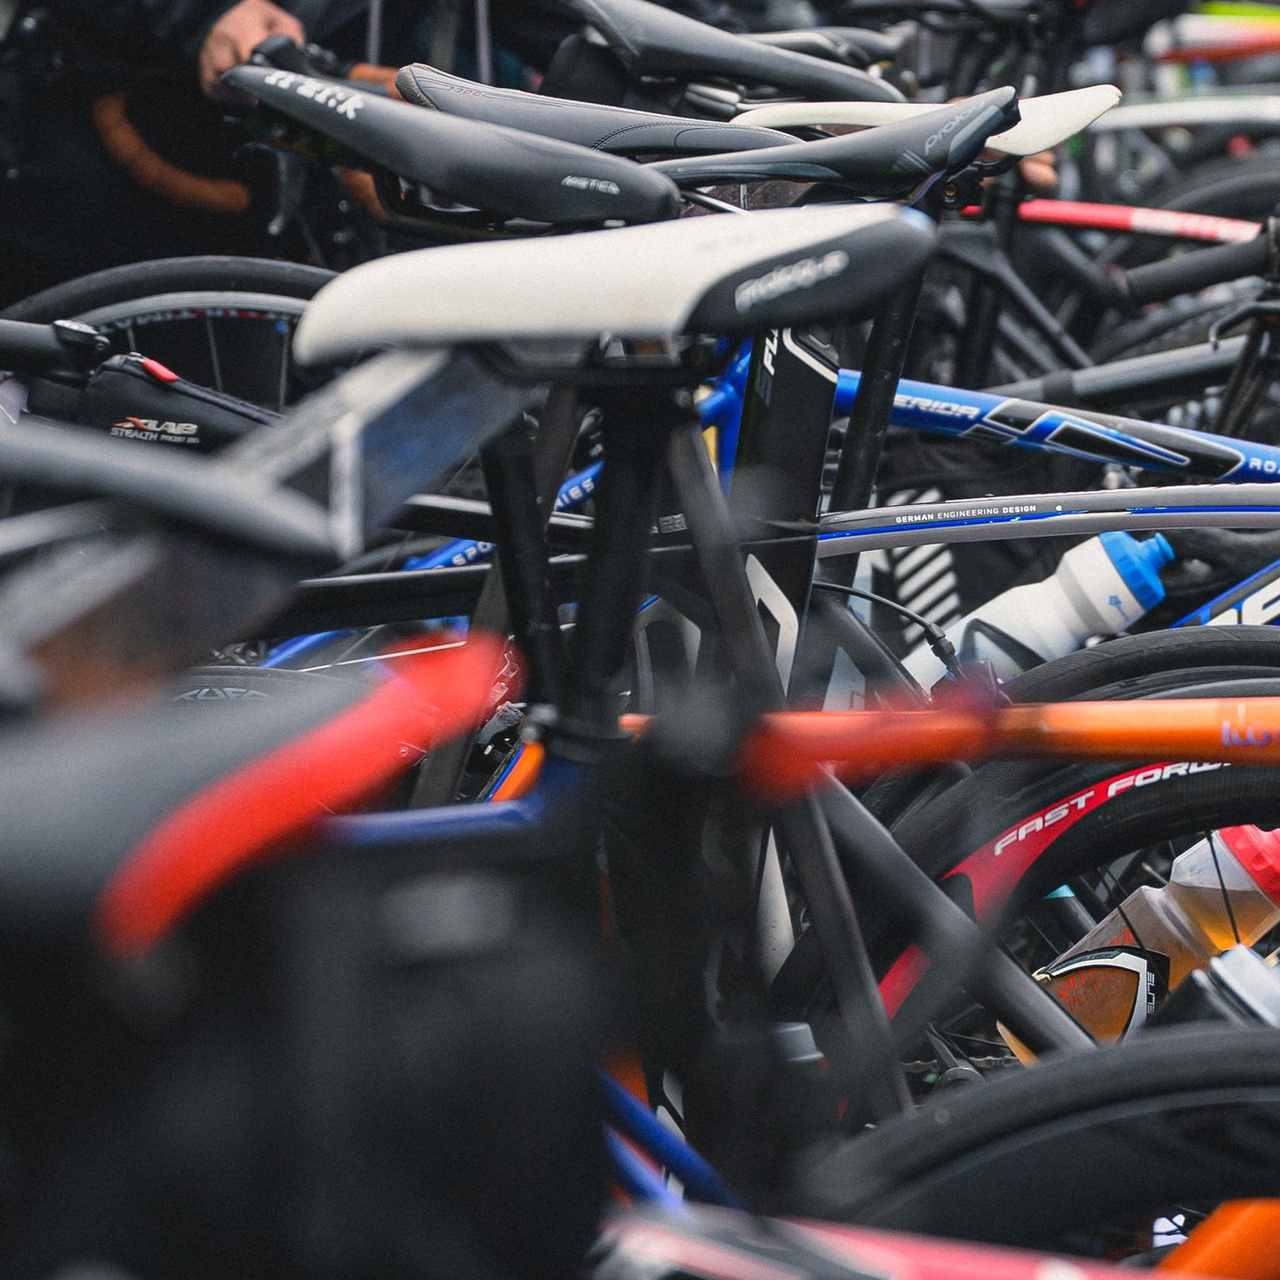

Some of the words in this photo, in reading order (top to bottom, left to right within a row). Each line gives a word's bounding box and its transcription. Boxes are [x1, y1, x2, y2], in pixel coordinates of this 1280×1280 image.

[893, 393, 981, 419] ERIDA
[110, 427, 159, 441] STEALTH
[895, 513, 935, 524] GERMAN
[937, 507, 1000, 520] ENGINEERING
[1002, 504, 1037, 514] DESIGN
[994, 790, 1095, 857] FAST
